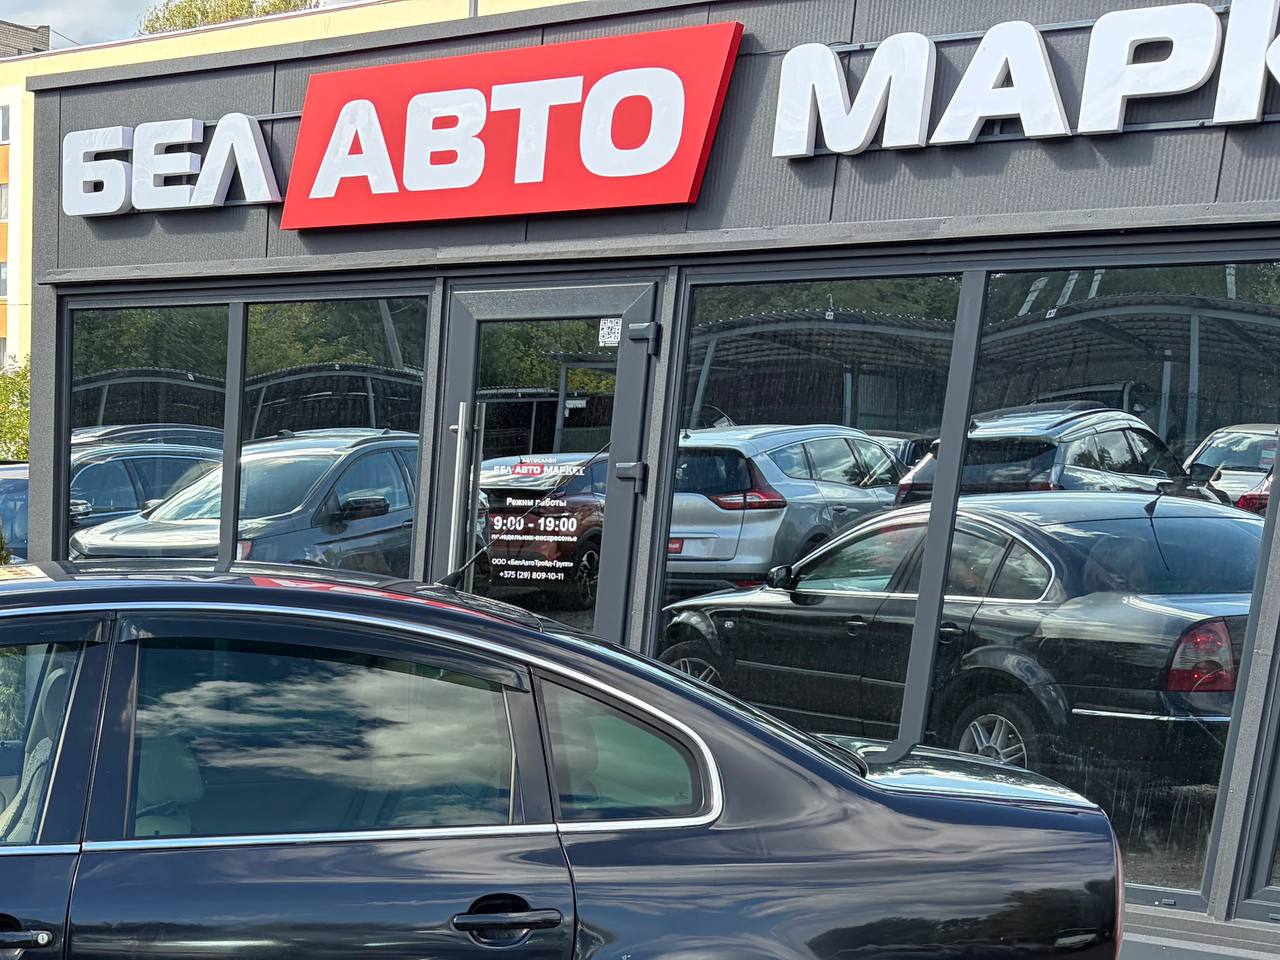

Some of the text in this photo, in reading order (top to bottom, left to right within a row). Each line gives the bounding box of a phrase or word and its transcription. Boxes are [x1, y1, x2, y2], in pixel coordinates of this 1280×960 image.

[61, 111, 282, 218] БЕЛ
[308, 66, 687, 200] АВТО
[514, 464, 541, 474] АВТО
[506, 497, 534, 507] Режим
[493, 516, 525, 531] 9:00
[537, 516, 578, 532] 19:00
[499, 570, 564, 581] +375 (29) 809-10-11
